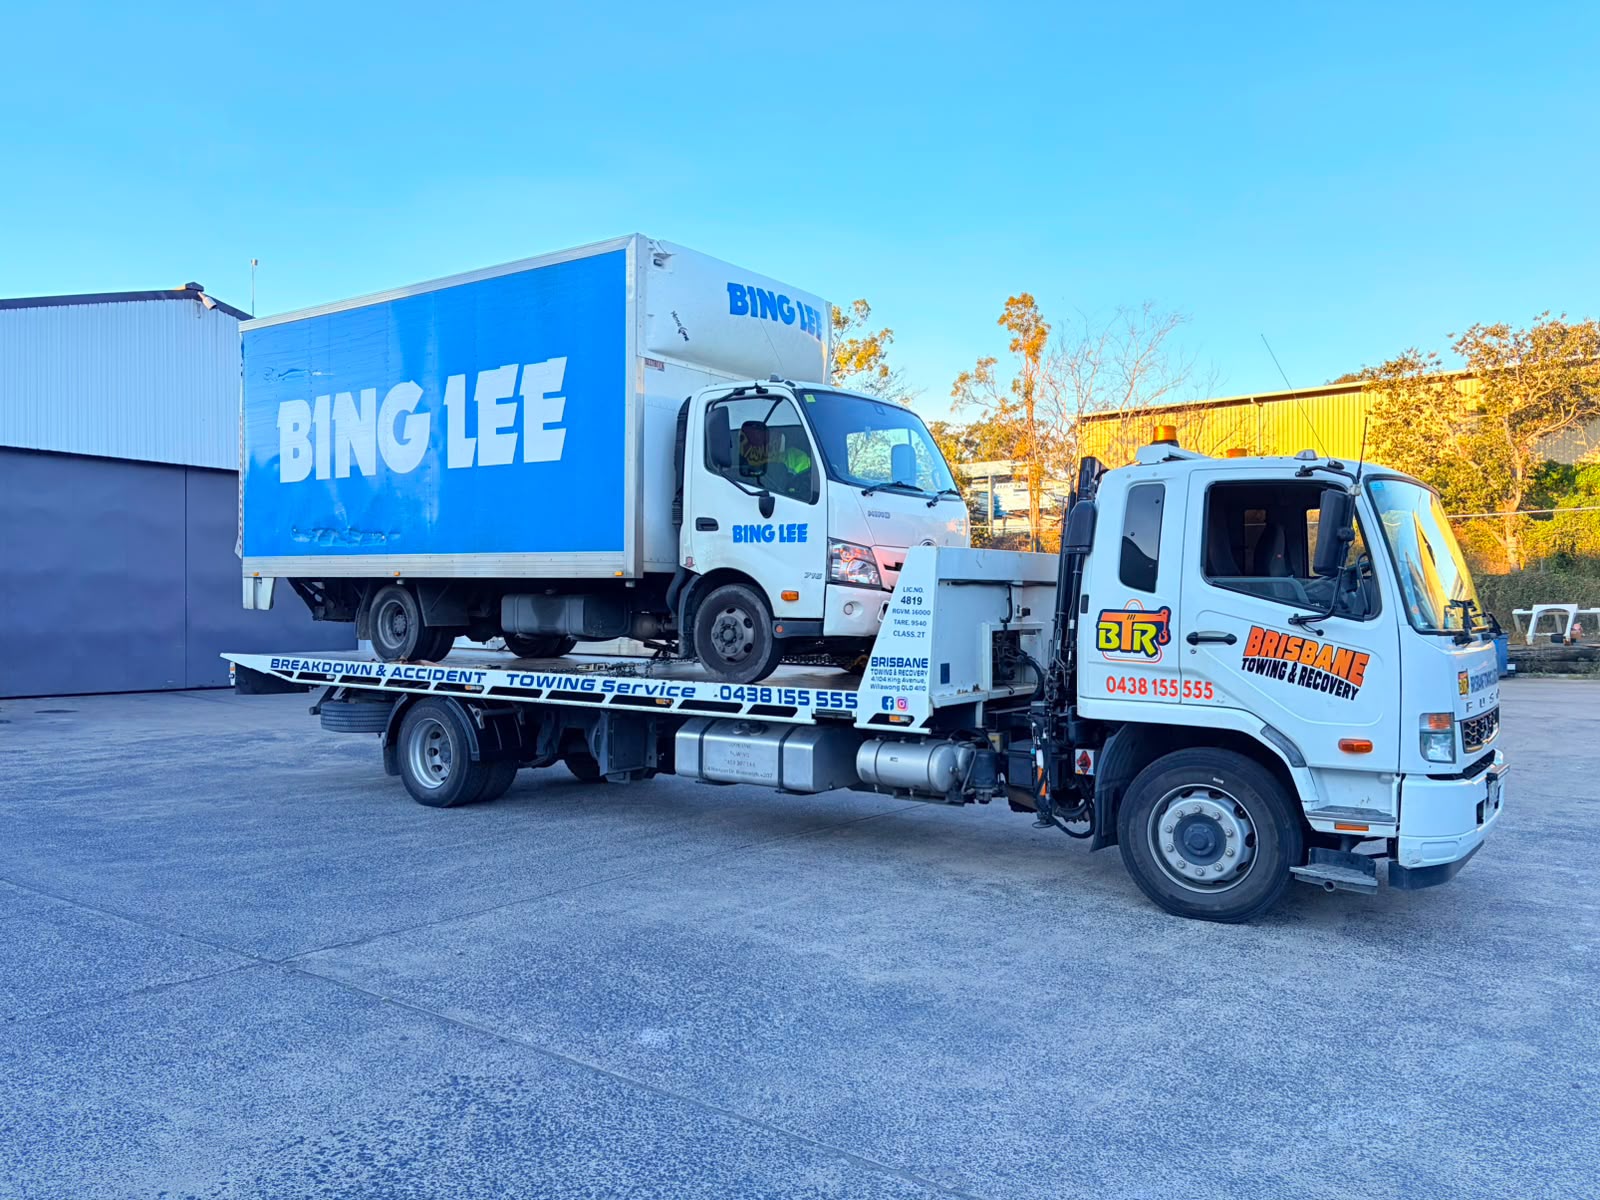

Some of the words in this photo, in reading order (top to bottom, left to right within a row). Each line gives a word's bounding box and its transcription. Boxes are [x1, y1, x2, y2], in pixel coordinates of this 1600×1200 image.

[727, 281, 796, 325] BING
[796, 300, 823, 342] LEE
[276, 379, 431, 484] BING
[443, 356, 568, 469] LEE
[732, 524, 776, 544] BING
[778, 522, 808, 543] LEE
[900, 595, 923, 605] 4819
[1097, 609, 1169, 656] BTR
[870, 657, 929, 669] BRISBANE
[1243, 625, 1370, 687] BRISBANE
[270, 658, 373, 676] BREAKDOWN
[375, 665, 386, 676] &
[390, 667, 487, 684] ACCIDENT
[870, 668, 893, 676] TOWING
[898, 669, 928, 677] RECOVERY
[887, 677, 901, 685] King
[1240, 656, 1288, 681] TOWING
[1288, 664, 1297, 684] &
[1297, 665, 1359, 701] RECOVERY
[506, 673, 596, 692] TOWING
[601, 680, 696, 698] Service
[719, 685, 773, 703] 0438
[777, 688, 811, 707] 155
[815, 691, 859, 709] 555
[901, 684, 914, 692] QLD
[1106, 675, 1148, 695] 0438
[1151, 678, 1179, 698] 155
[1182, 679, 1214, 699] 555
